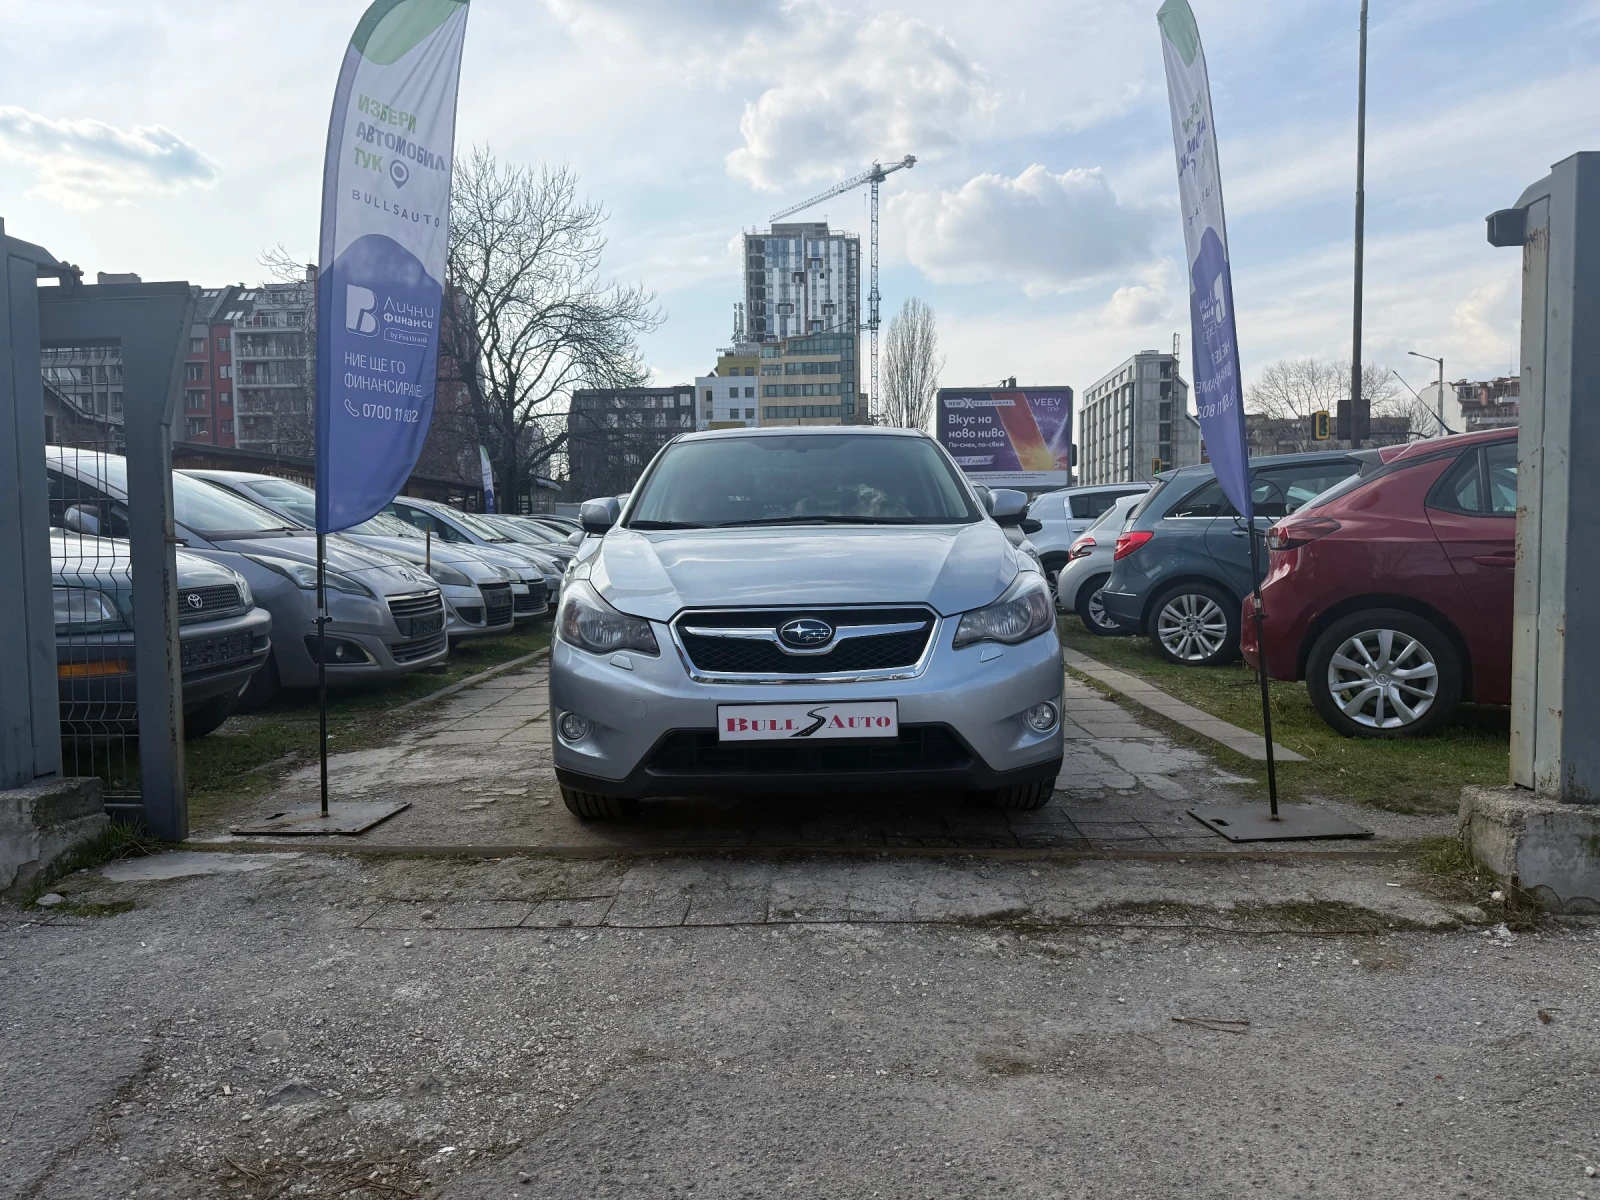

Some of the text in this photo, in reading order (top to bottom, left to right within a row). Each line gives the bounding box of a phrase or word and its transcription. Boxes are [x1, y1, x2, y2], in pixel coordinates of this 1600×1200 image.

[357, 93, 417, 134] ИЗБЕРИ
[356, 121, 446, 171] АВТОМОБИЛ
[354, 146, 383, 173] ТУК
[352, 189, 440, 228] BULLSAUTO
[384, 296, 434, 318] Лични
[390, 332, 398, 340] by
[344, 351, 405, 374] НИЕ ЩЕ ГО
[363, 403, 391, 420] 0700
[1033, 398, 1061, 406] VEEV
[948, 414, 992, 427] Вкус на
[948, 428, 1005, 438] ново ниво
[725, 718, 799, 732] BULL
[827, 714, 891, 729] AUTO
